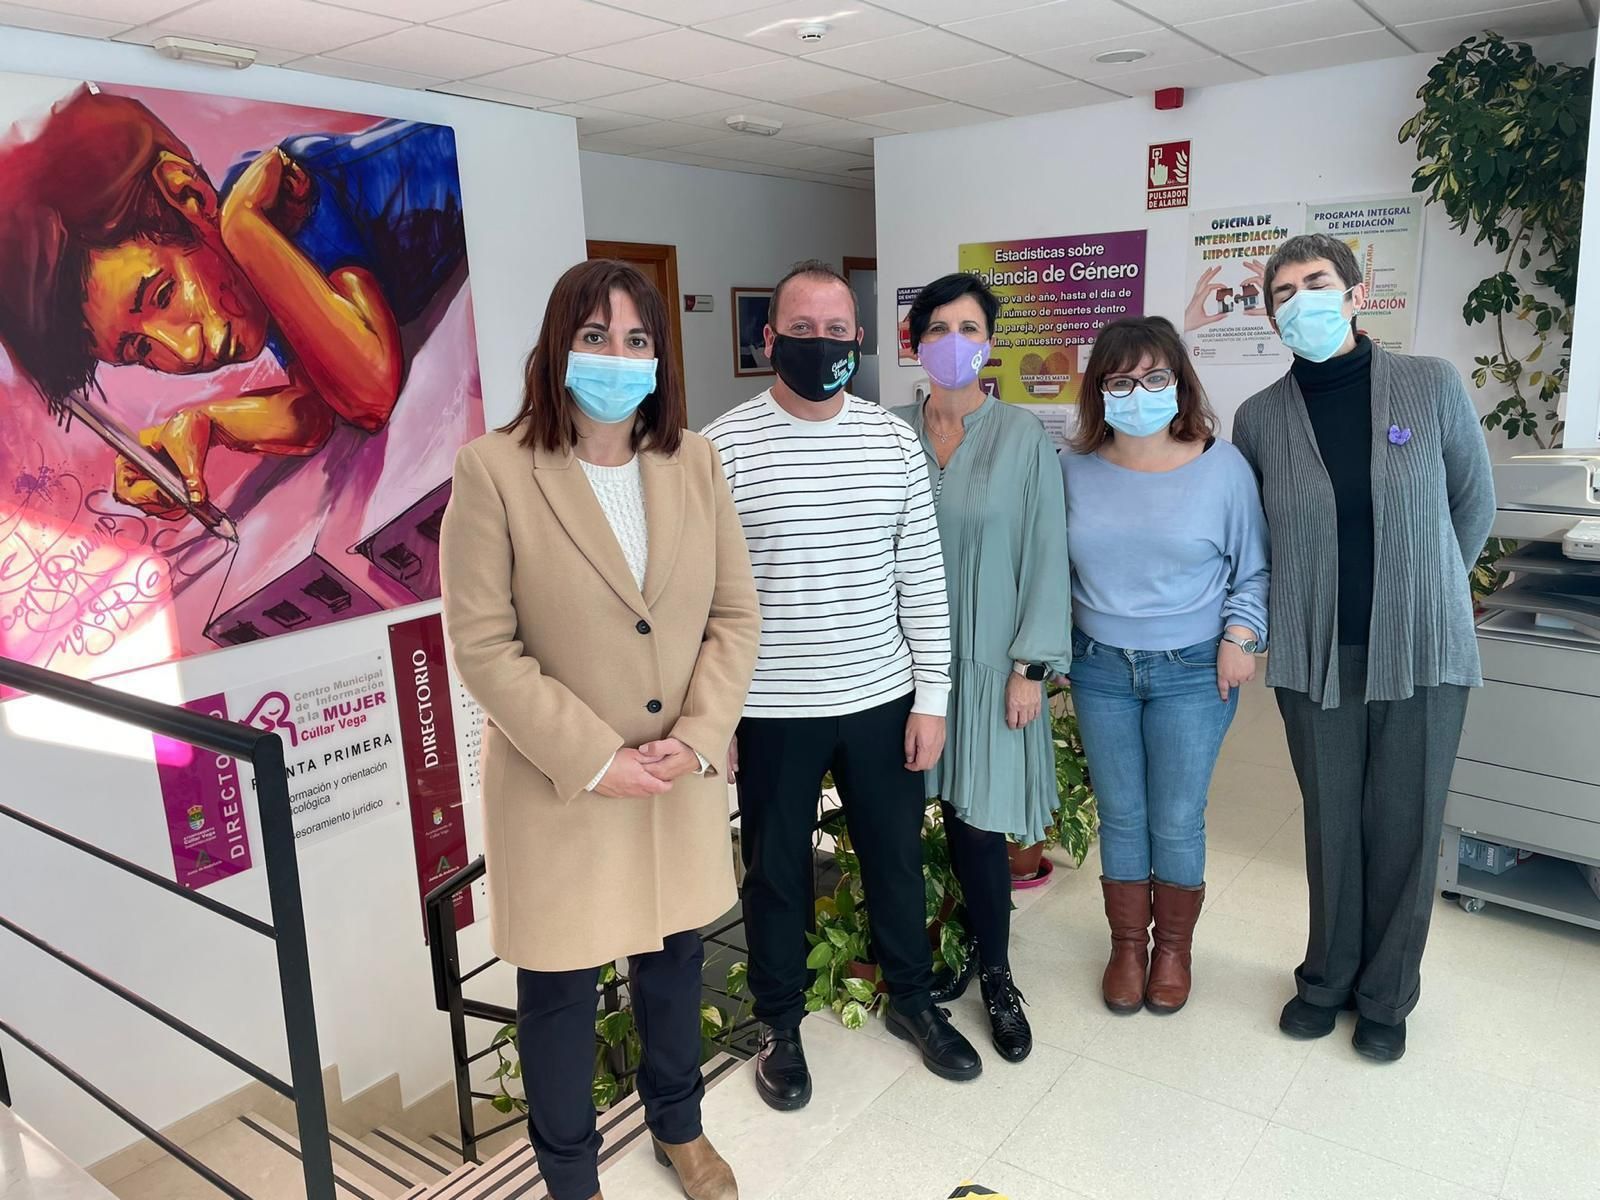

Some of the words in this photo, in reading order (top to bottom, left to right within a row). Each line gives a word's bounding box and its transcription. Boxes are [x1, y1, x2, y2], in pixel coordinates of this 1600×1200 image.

[1149, 190, 1187, 200] PULSADOR
[1149, 200, 1157, 208] DE
[1159, 198, 1186, 207] ALARMA
[1211, 216, 1254, 230] OFICINA
[1257, 214, 1271, 226] DE
[1314, 210, 1364, 220] PROGRAMA
[1367, 207, 1411, 217] INTEGRAL
[1342, 217, 1394, 229] MEDIACIÓN
[1195, 226, 1288, 246] INTERMEDIACIÓN
[995, 247, 1065, 263] Estadísticas
[1068, 243, 1104, 257] sobre
[964, 266, 1038, 287] olencia
[1042, 264, 1065, 282] de
[1069, 261, 1139, 281] Género
[1024, 293, 1036, 302] de
[1038, 292, 1058, 303] año,
[1060, 290, 1086, 300] hasta
[1089, 289, 1098, 299] el
[1100, 288, 1116, 298] día
[1118, 288, 1132, 298] de
[1361, 296, 1406, 310] DIACIÓN
[1003, 308, 1037, 317] número
[1039, 307, 1051, 316] de
[1053, 306, 1091, 315] muertes
[1094, 304, 1126, 314] dentro
[994, 322, 1003, 332] la
[1005, 323, 1036, 334] pareja,
[1039, 323, 1053, 334] por
[1057, 320, 1089, 333] género
[1092, 320, 1104, 329] de
[1028, 337, 1062, 346] nuestro
[985, 383, 995, 394] 7
[294, 686, 330, 701] Centro
[333, 669, 383, 690] Municipal
[295, 703, 309, 712] de
[317, 681, 384, 706] Información
[307, 711, 319, 721] la
[323, 691, 386, 721] MUJER
[412, 649, 439, 768] DIRECTORIO
[301, 723, 335, 741] Cúllar
[338, 714, 367, 729] Vega
[251, 759, 317, 791] PNTA
[324, 733, 392, 766] PRIMERA
[208, 709, 244, 860] DIRECTOO
[289, 781, 332, 803] ormación
[333, 779, 339, 791] y
[341, 761, 388, 785] orientación
[290, 794, 331, 816] icológica
[294, 811, 350, 839] esoramiento
[352, 799, 383, 819] jurídico
